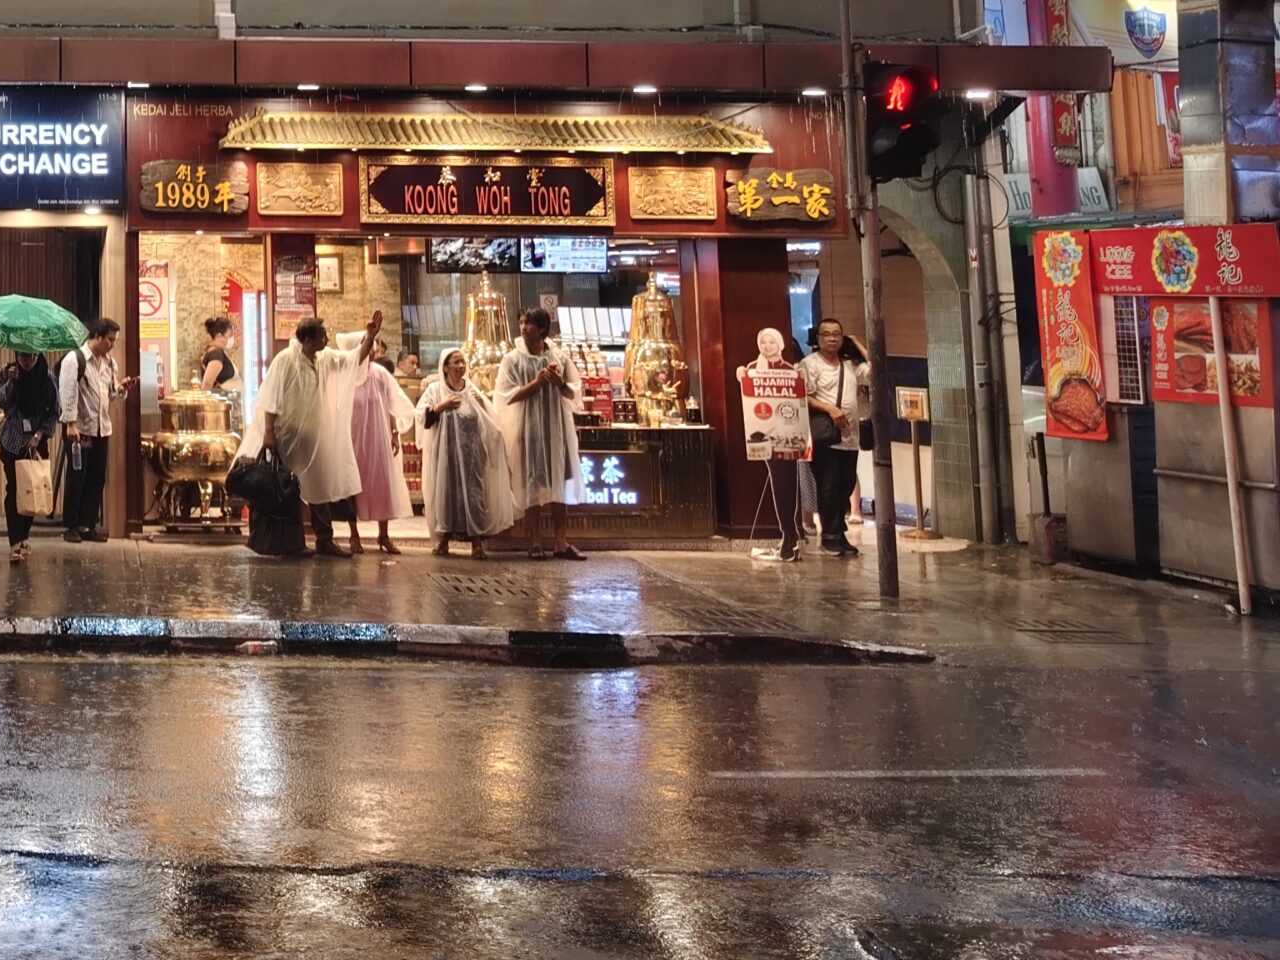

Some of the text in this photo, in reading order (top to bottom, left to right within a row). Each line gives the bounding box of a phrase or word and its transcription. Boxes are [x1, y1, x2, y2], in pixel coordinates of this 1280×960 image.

[133, 104, 233, 117] KEDAI JELI HERBA
[404, 185, 571, 216] KOONG WOH TONG
[738, 179, 832, 218] 第一家
[753, 378, 795, 387] DIJAMIN
[754, 387, 797, 397] HALAL
[611, 488, 637, 504] Tea
